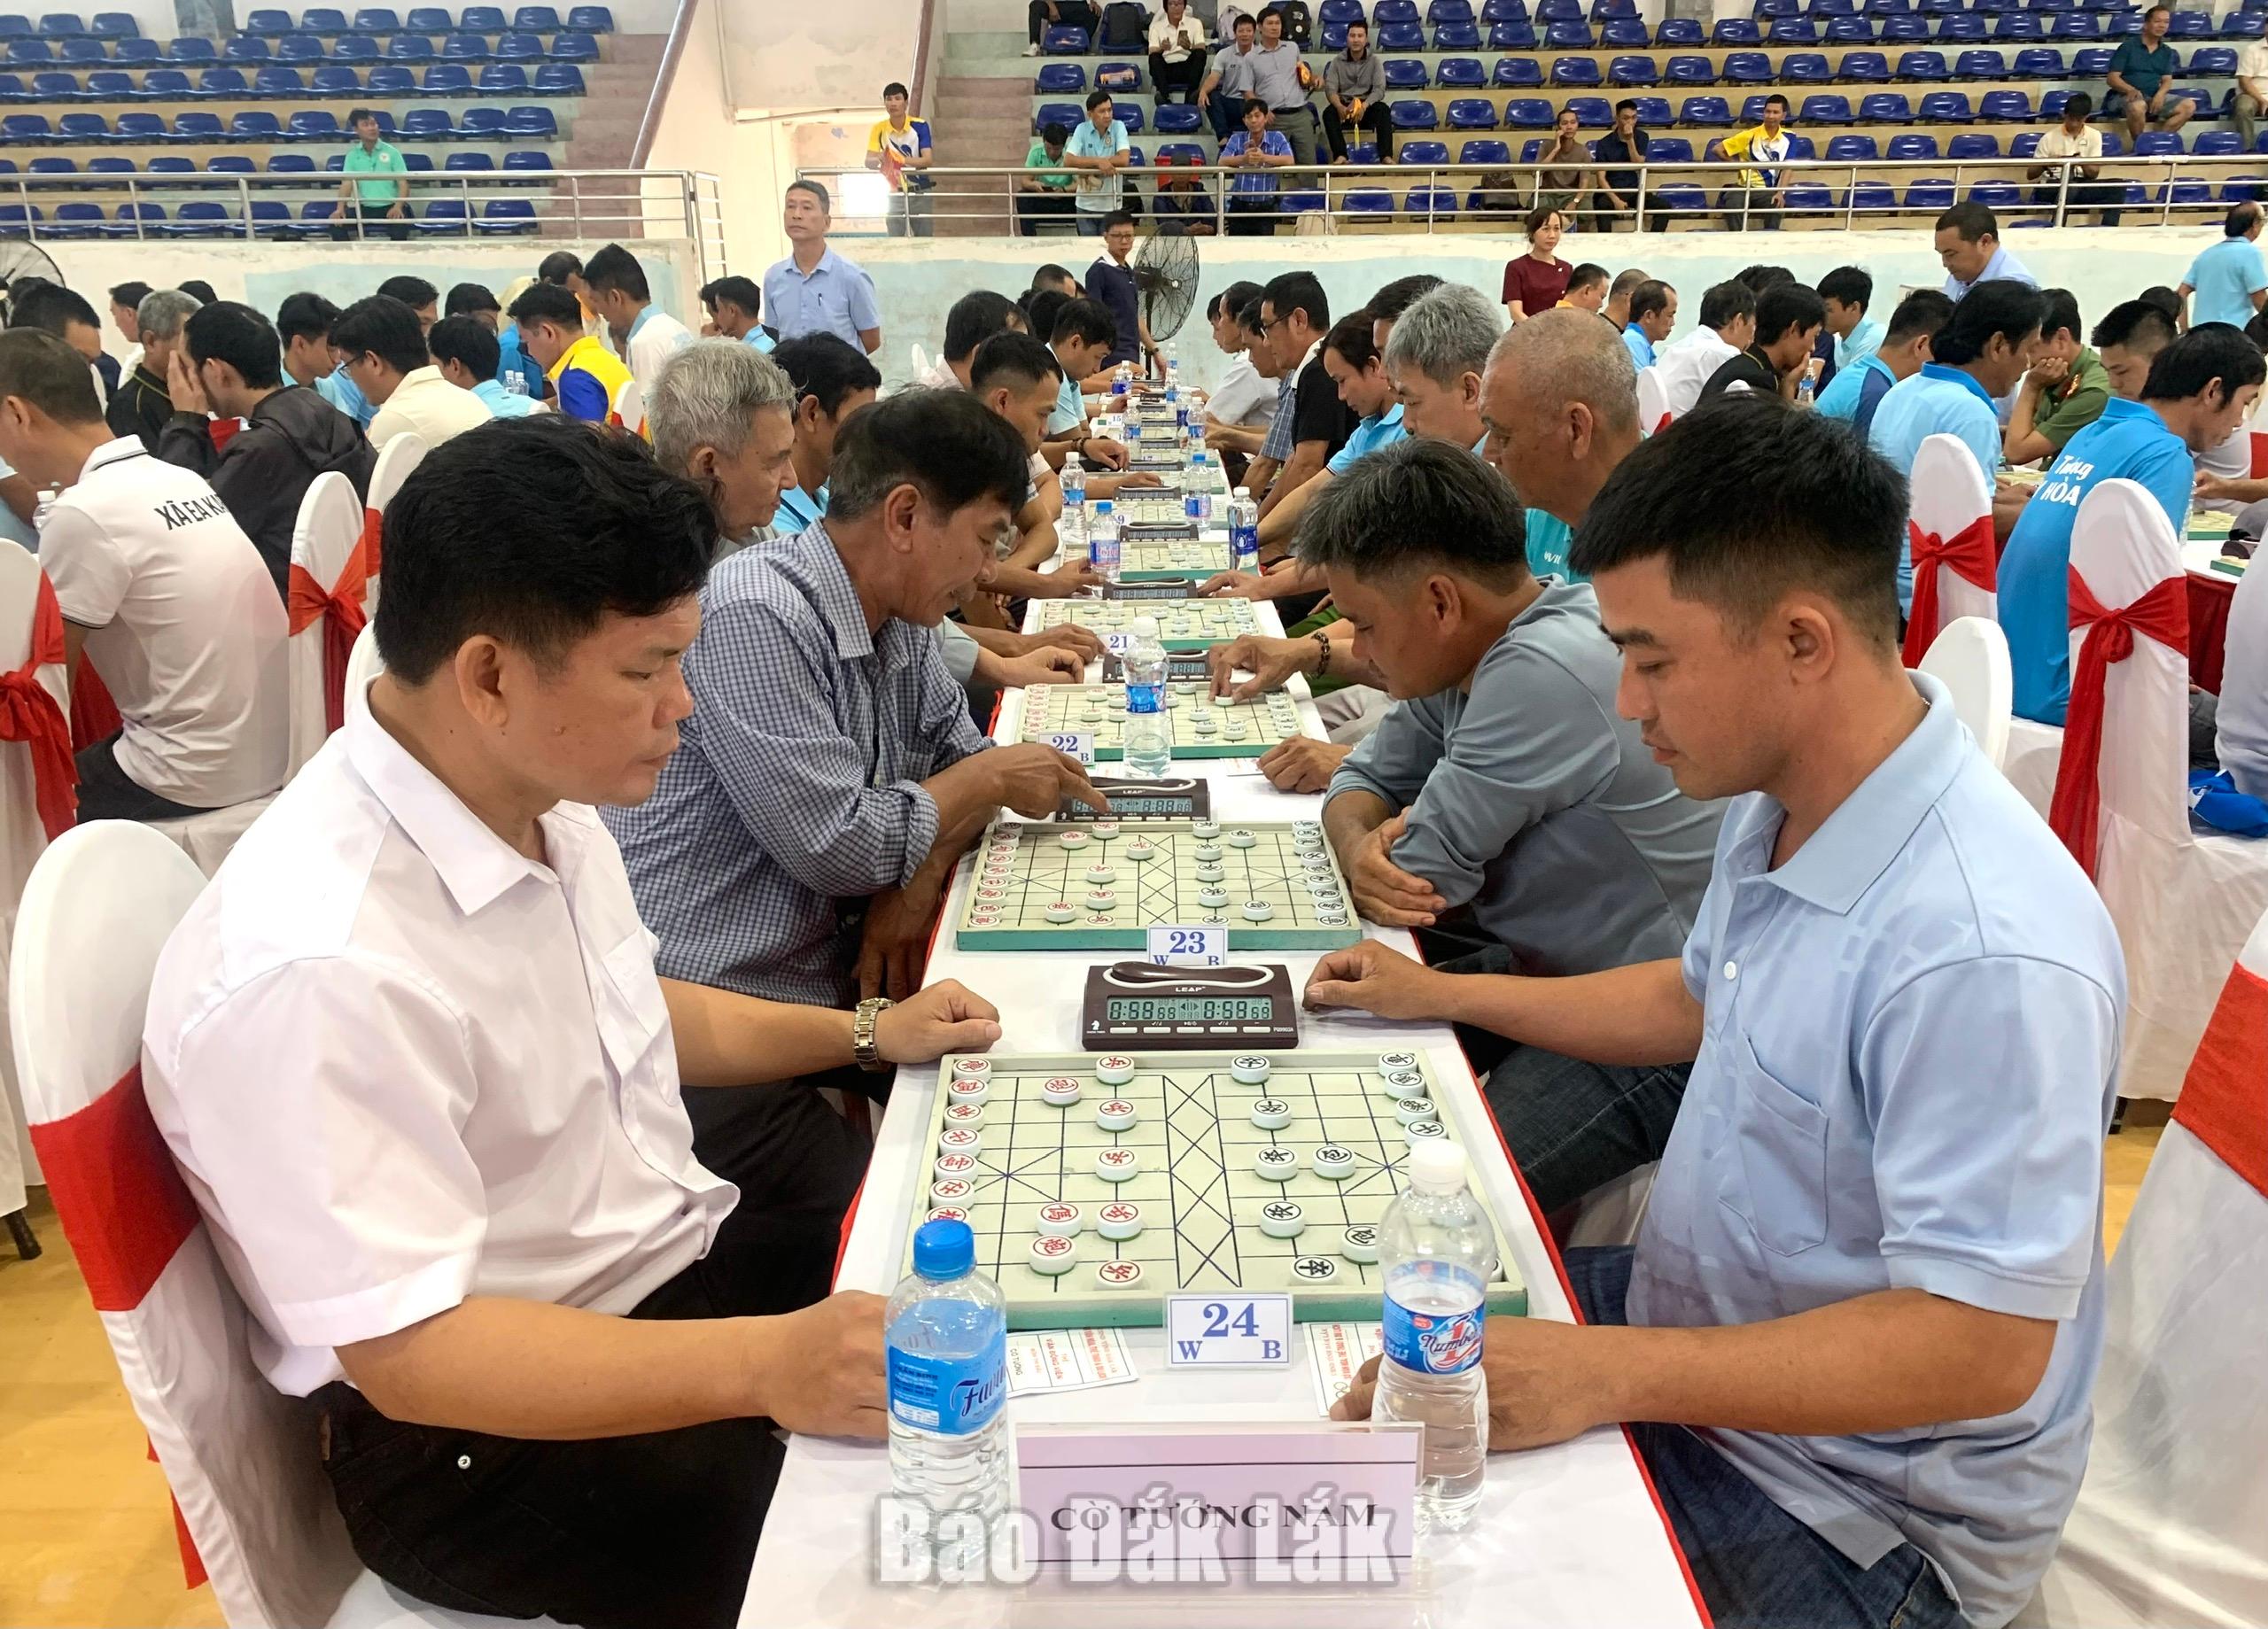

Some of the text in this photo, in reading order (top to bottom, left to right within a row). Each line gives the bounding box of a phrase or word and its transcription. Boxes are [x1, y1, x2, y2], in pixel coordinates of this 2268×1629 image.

[153, 500, 193, 531] XÃ
[182, 500, 213, 522] EA
[1109, 635, 1128, 648] 21
[1052, 735, 1078, 752] 22
[1080, 752, 1090, 762] B
[1169, 931, 1205, 954] 23
[1153, 955, 1169, 966] W
[1207, 955, 1220, 966] B
[1202, 1302, 1259, 1337] 24
[1177, 1340, 1203, 1360] W
[1262, 1339, 1281, 1359] B
[1051, 1501, 1110, 1531] CỜ
[1121, 1499, 1271, 1530] TƯỚNG
